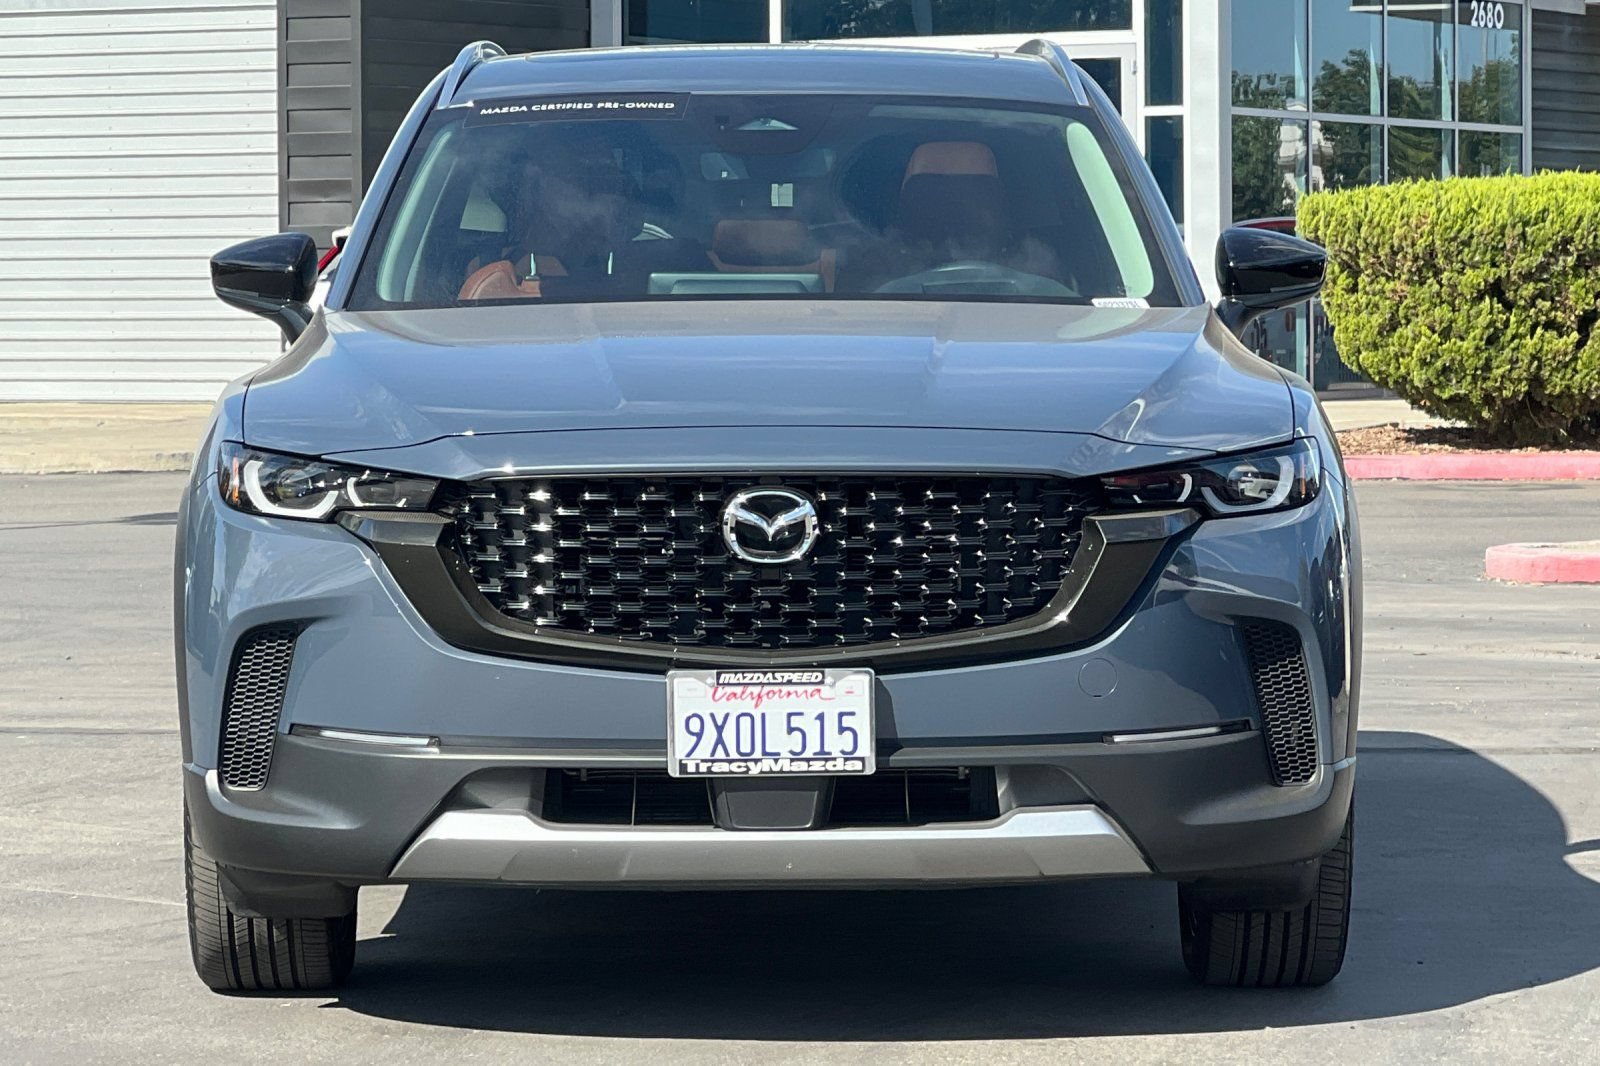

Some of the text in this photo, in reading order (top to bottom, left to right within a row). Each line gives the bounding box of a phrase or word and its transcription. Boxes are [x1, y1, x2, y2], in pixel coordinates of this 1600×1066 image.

[1470, 0, 1504, 29] 2680
[480, 105, 528, 115] MAZDA
[531, 102, 593, 111] CERTIFIED
[719, 671, 823, 684] MAZDASPEED
[711, 685, 836, 709] California
[681, 758, 863, 775] TracyMazda
